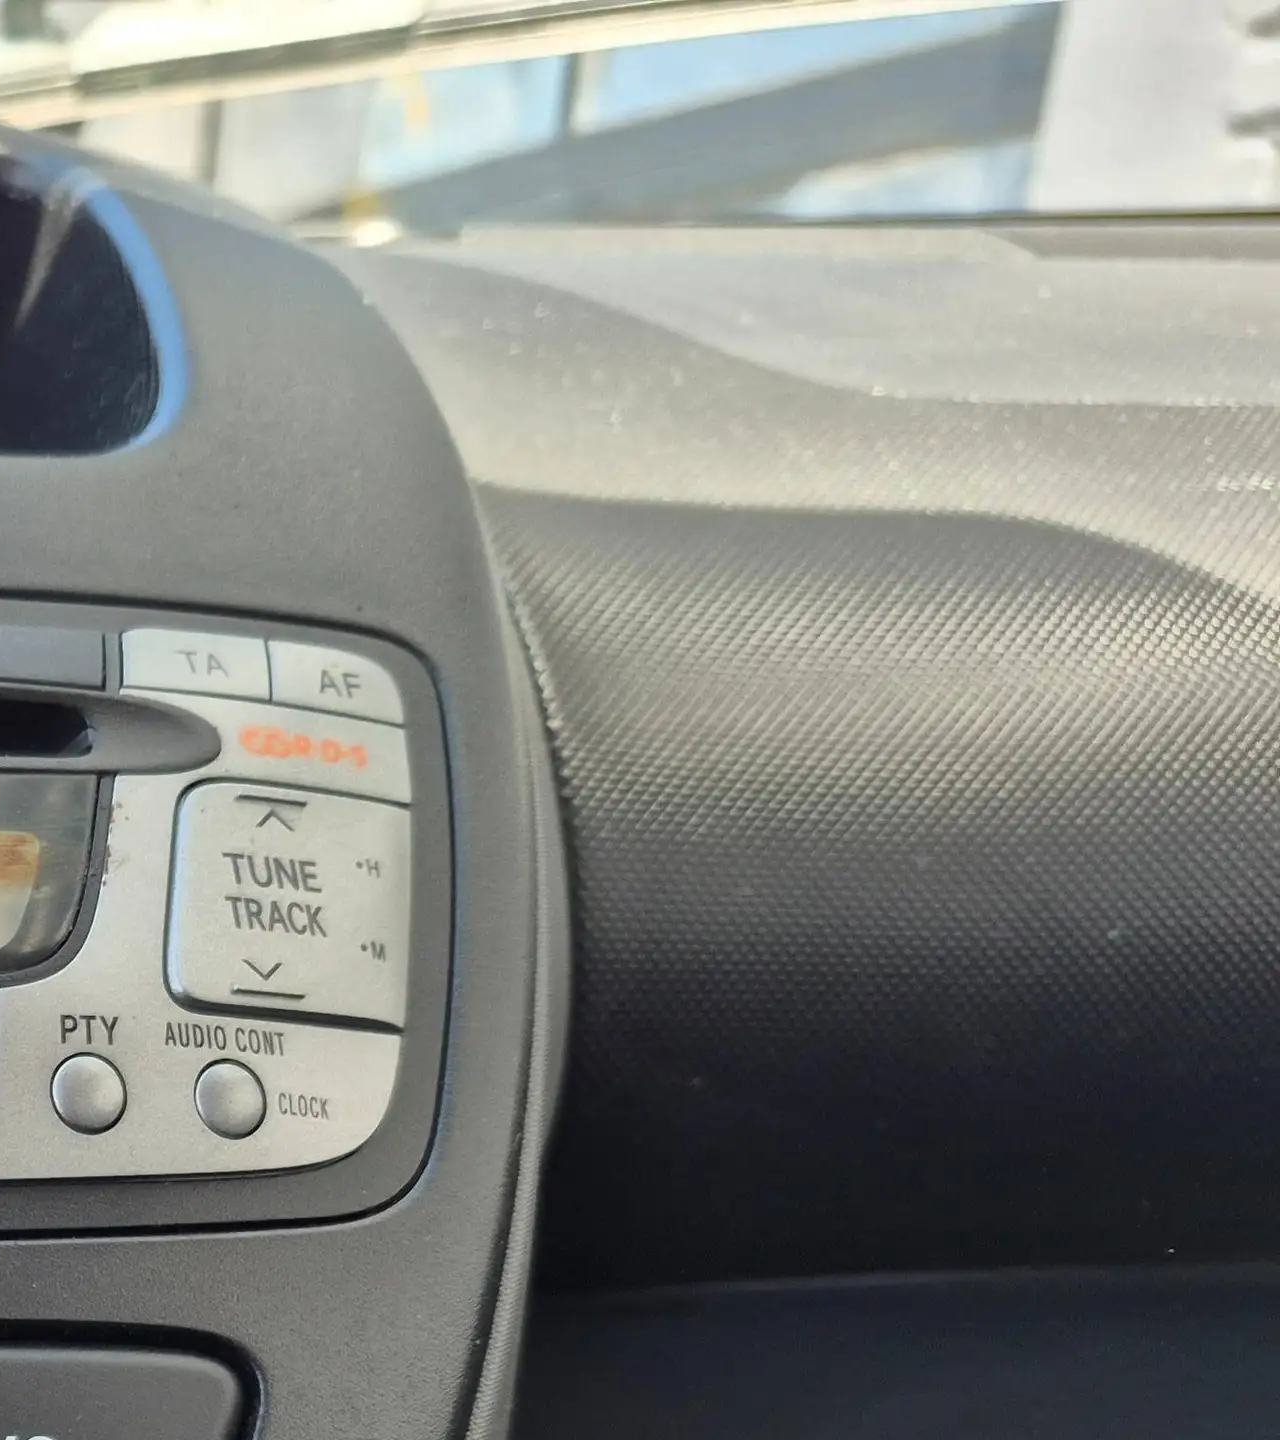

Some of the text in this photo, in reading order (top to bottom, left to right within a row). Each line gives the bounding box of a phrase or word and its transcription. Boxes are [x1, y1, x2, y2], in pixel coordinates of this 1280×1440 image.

[173, 650, 230, 678] TA
[318, 669, 363, 699] AF
[221, 852, 322, 893] TUNE
[224, 895, 327, 938] TRACK
[60, 1014, 119, 1046] PTY
[164, 1021, 285, 1056] AUDIO CONT
[277, 1092, 330, 1119] CLOCK
